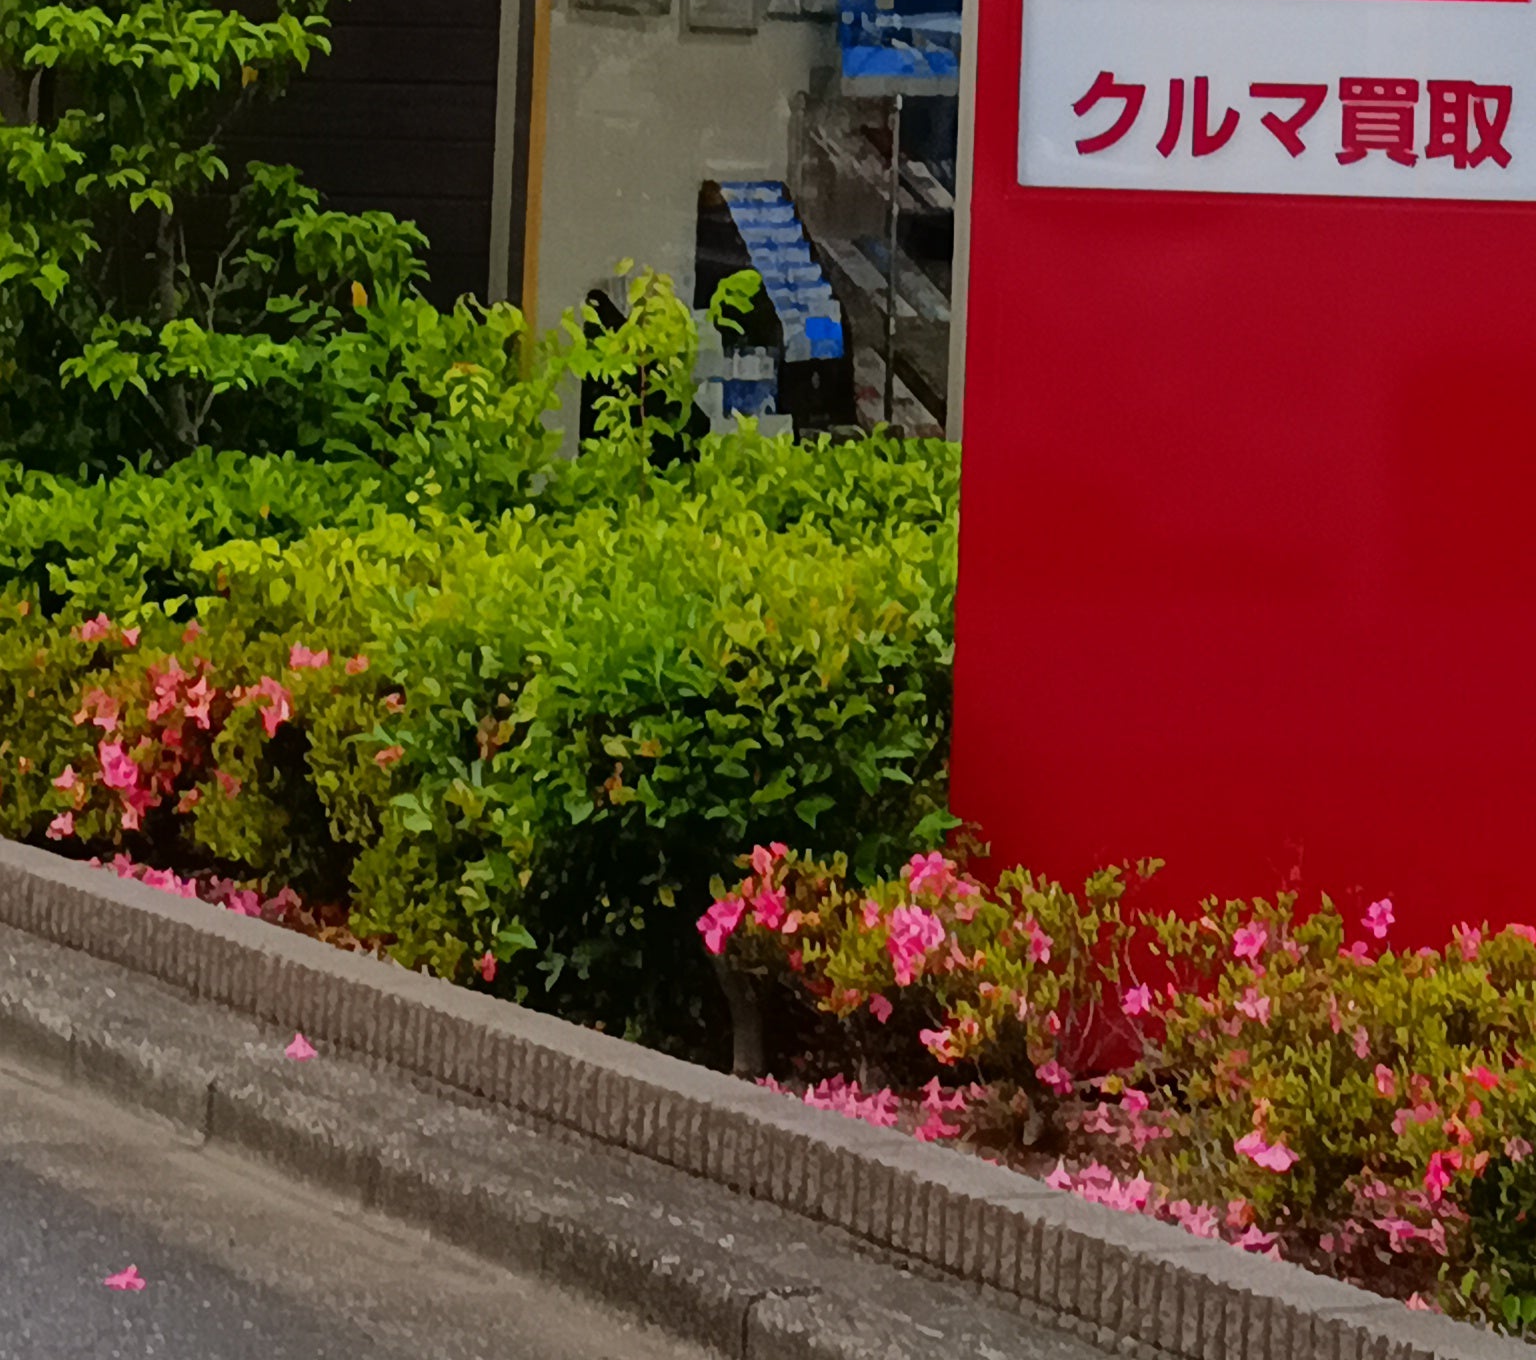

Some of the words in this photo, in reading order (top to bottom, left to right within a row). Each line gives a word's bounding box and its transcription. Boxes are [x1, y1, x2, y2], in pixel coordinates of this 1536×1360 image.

[1071, 70, 1514, 170] クルマ買取
